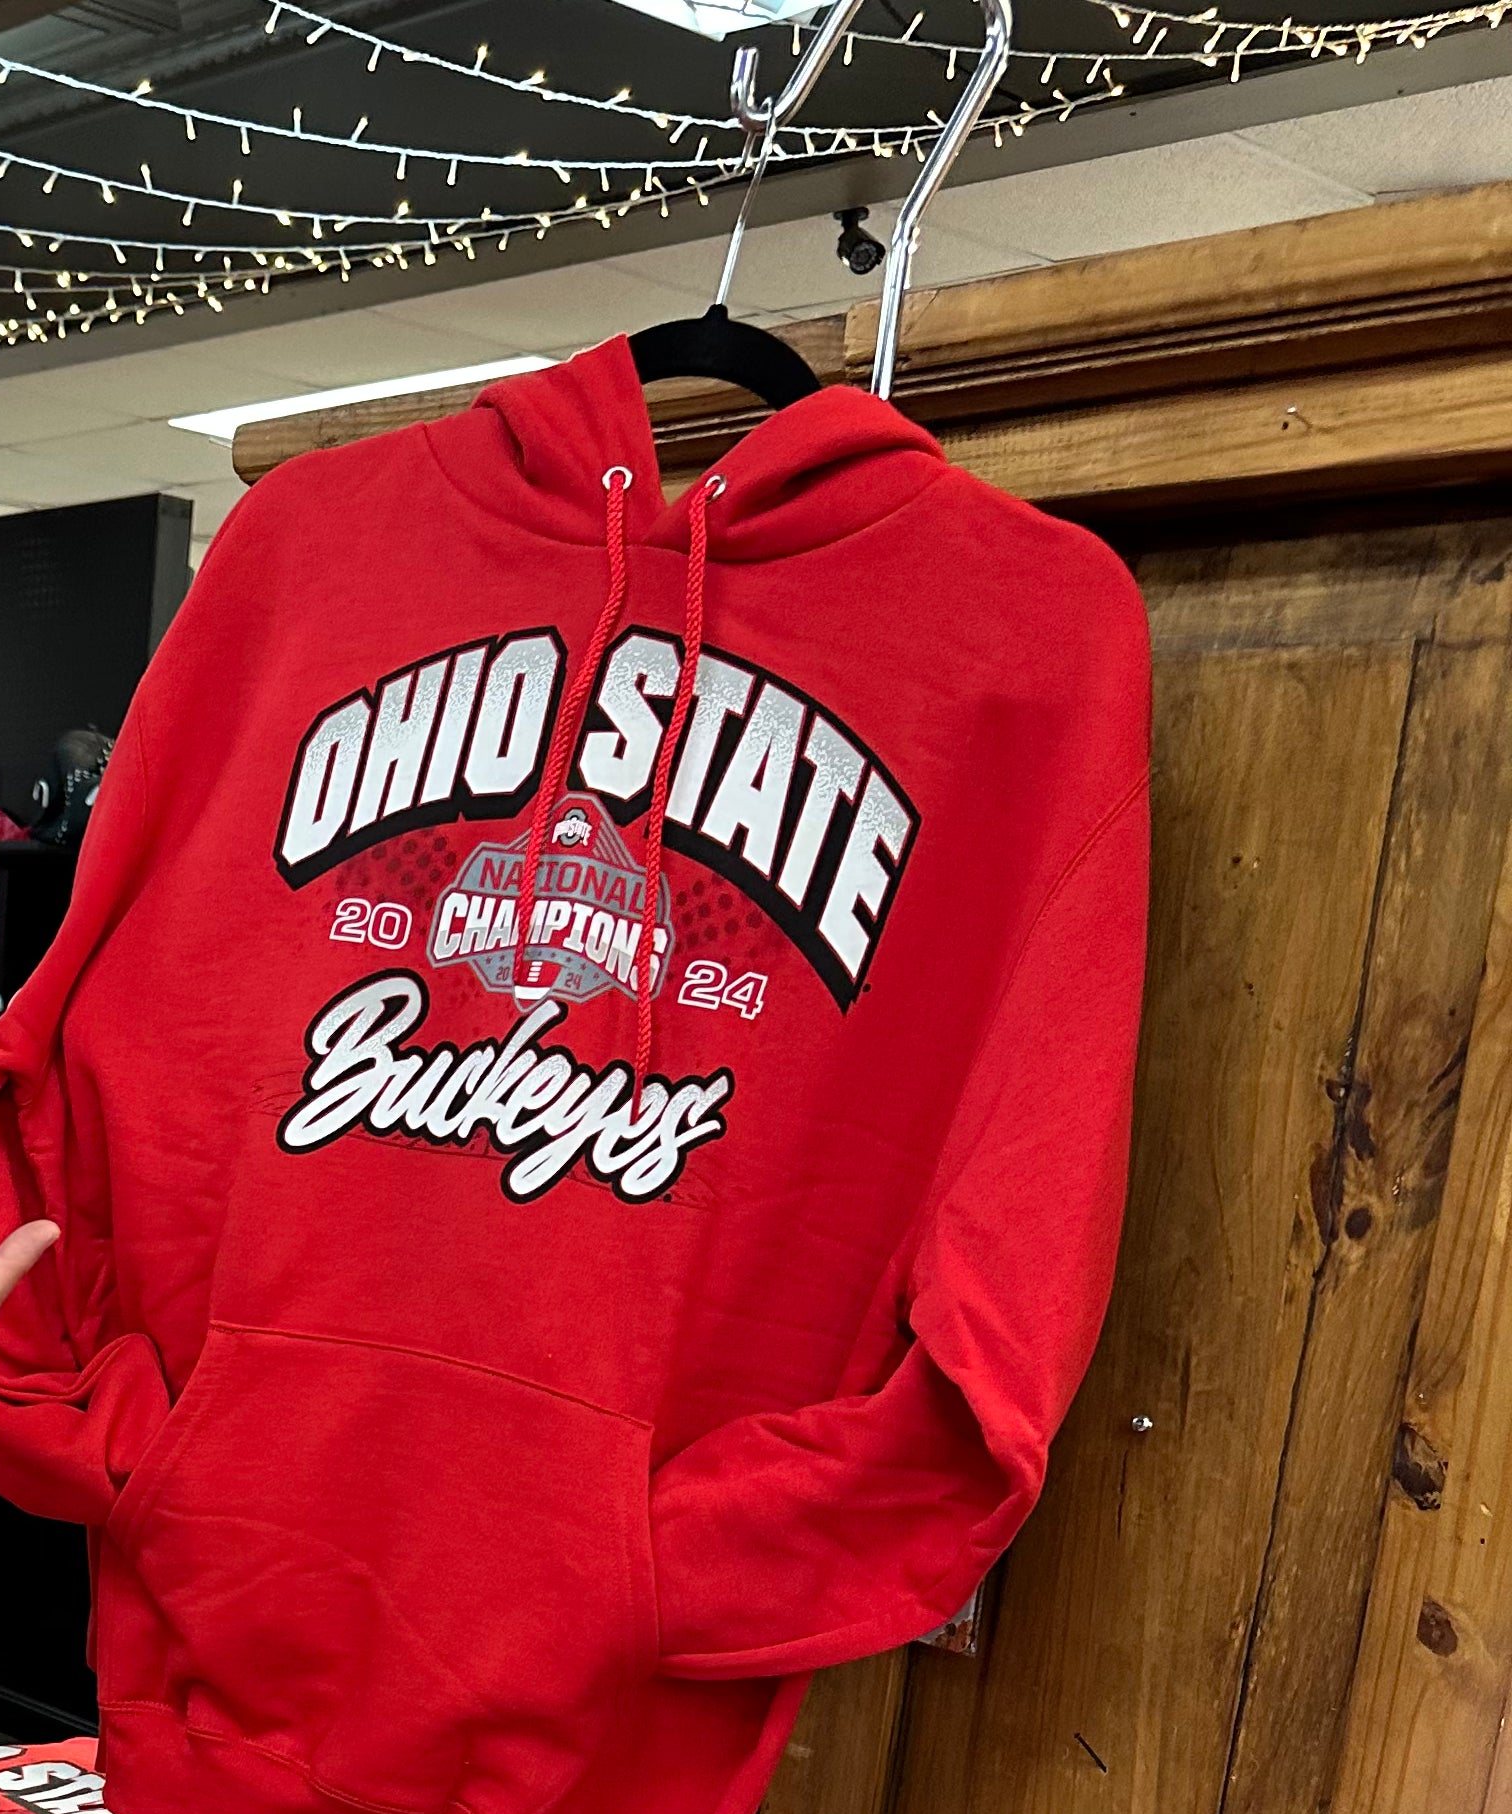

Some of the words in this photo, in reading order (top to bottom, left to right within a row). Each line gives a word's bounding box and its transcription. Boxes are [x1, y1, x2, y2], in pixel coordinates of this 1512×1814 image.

[276, 628, 566, 880] OHIO
[577, 627, 918, 1000] STATE
[478, 856, 651, 914] NAIONAL
[329, 898, 412, 950] 20
[433, 892, 668, 992] CHAMPIONS
[564, 971, 582, 990] 24
[677, 959, 768, 1019] 24
[280, 970, 731, 1200] Buckeyes
